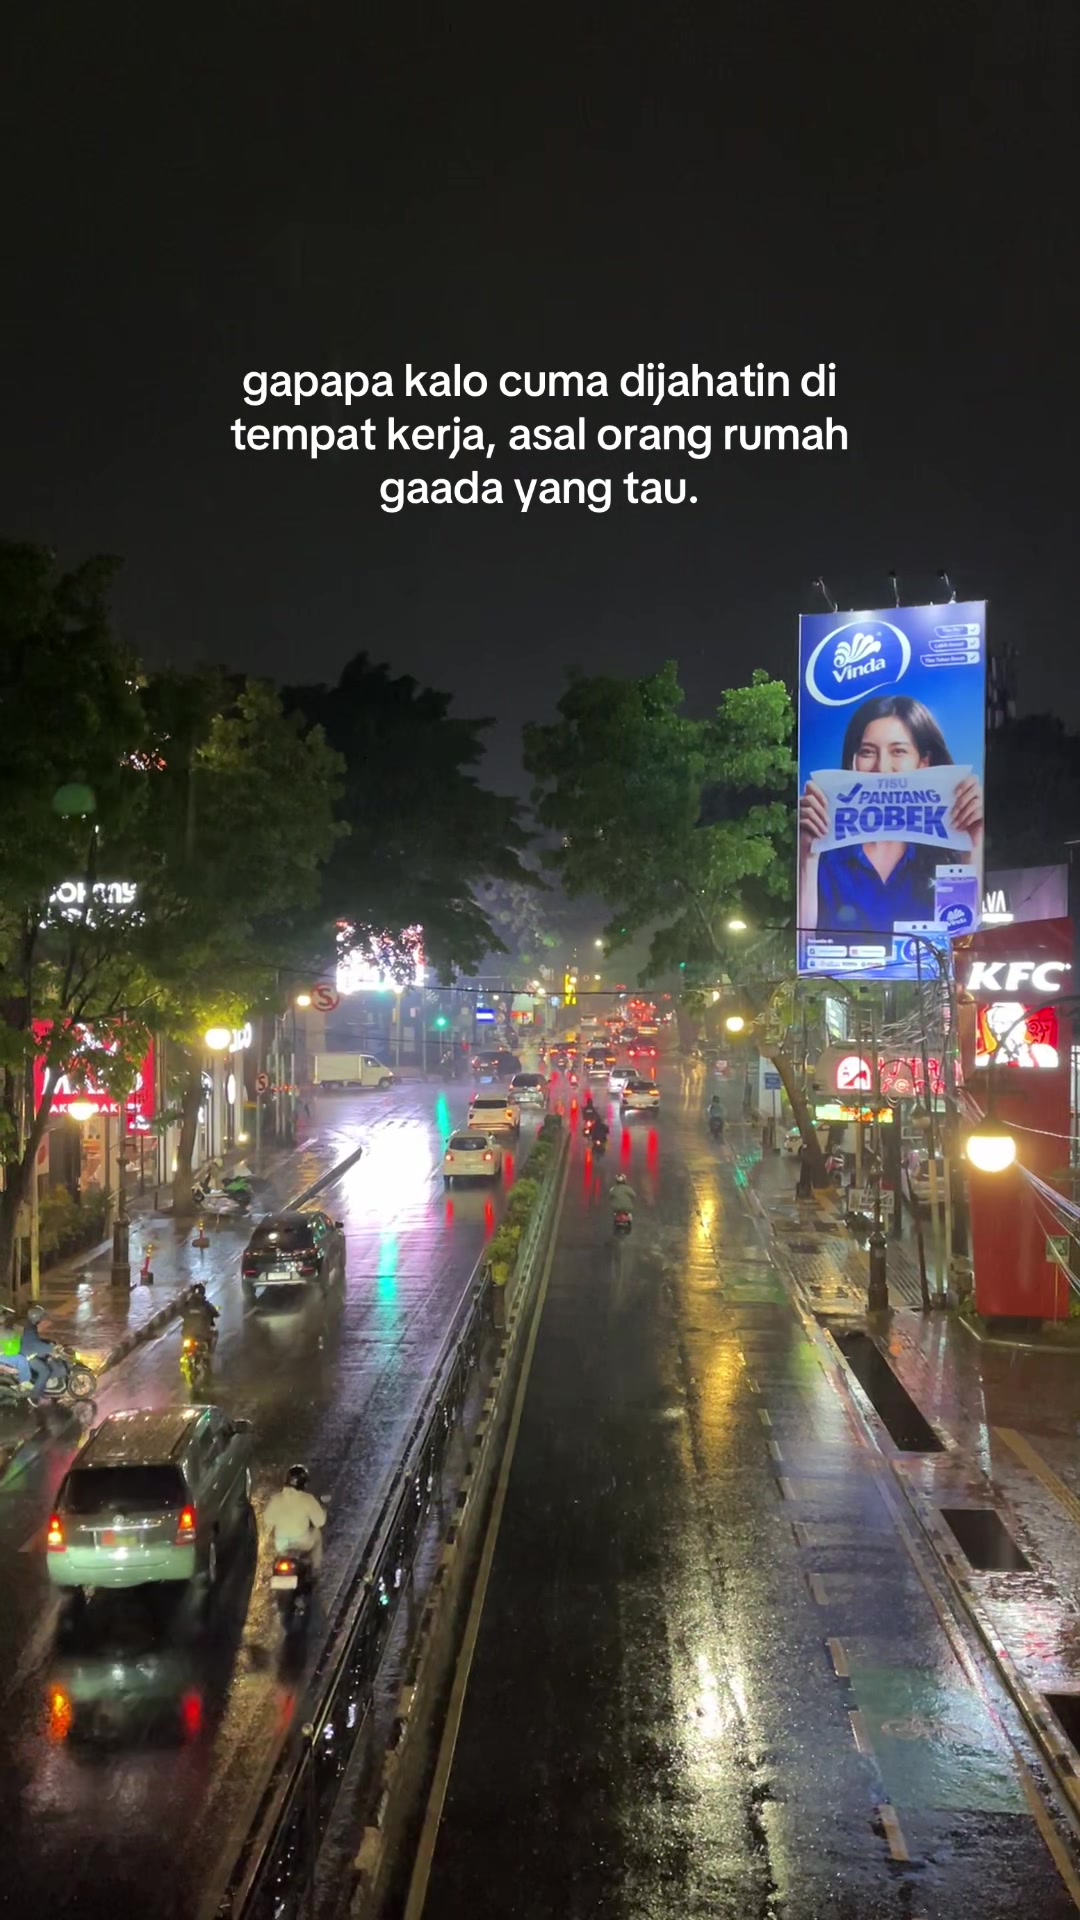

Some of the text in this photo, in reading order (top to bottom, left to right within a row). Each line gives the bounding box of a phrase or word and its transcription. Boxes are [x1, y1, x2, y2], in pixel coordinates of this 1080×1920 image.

[832, 658, 886, 683] Vinda
[877, 778, 909, 789] TISU
[858, 789, 941, 805] PANTANG
[834, 805, 949, 841] ROBEK
[966, 961, 1065, 992] KFC
